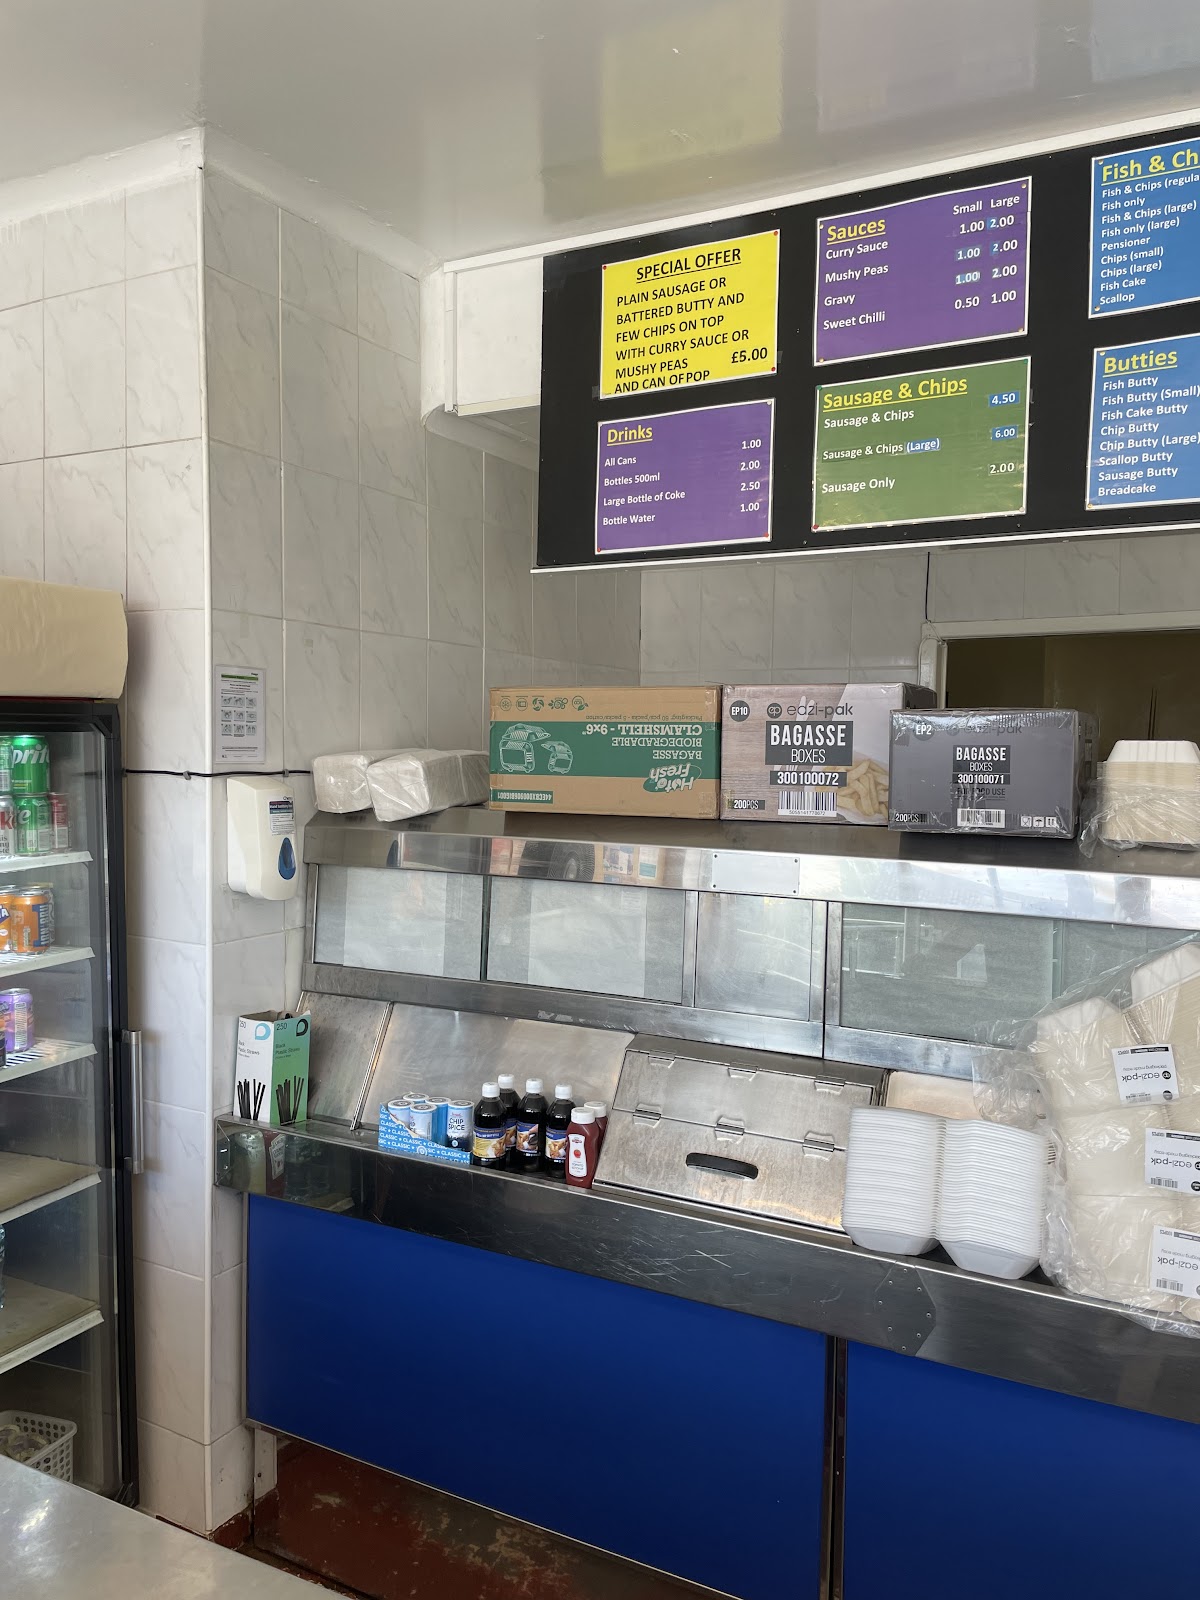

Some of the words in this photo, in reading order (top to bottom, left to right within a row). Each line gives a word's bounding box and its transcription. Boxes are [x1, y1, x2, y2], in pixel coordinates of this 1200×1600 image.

[1102, 160, 1141, 182] Fish
[1149, 155, 1165, 172] &
[1102, 185, 1121, 198] Fish
[1124, 183, 1132, 193] &
[1135, 180, 1162, 192] Chips
[953, 201, 982, 215] Small
[990, 195, 1020, 210] Large
[1102, 198, 1120, 211] Fish
[1124, 197, 1145, 208] only
[1102, 211, 1120, 224] Fish
[1124, 210, 1132, 220] &
[1135, 207, 1161, 219] Chips
[1164, 200, 1197, 215] (large)
[827, 219, 885, 242] Sauces
[960, 221, 984, 234] 1.00
[989, 215, 1014, 228] 2.00
[1102, 225, 1120, 238] Fish
[1124, 223, 1145, 234] only
[1147, 217, 1180, 232] (large)
[826, 246, 854, 260] Curry
[857, 241, 888, 254] Sauce
[957, 247, 980, 260] 1.00
[992, 240, 1018, 252] 2.00
[1101, 237, 1150, 251] Pensioner
[1101, 252, 1127, 265] Chips
[1130, 246, 1163, 261] (small)
[636, 258, 690, 281] SPECIAL
[696, 248, 741, 268] OFFER
[1101, 266, 1127, 278] Chips
[1130, 260, 1162, 275] (large)
[825, 269, 861, 283] Mushy
[864, 265, 888, 277] Peas
[956, 272, 979, 285] 1.00
[992, 265, 1017, 278] 2.00
[1100, 280, 1119, 291] Fish
[1122, 277, 1146, 288] Cake
[617, 291, 649, 307] PLAIN
[652, 280, 706, 300] SAUSAGE
[709, 277, 726, 289] OR
[1100, 293, 1134, 305] Scallop
[824, 294, 855, 306] Gravy
[955, 297, 980, 310] 0.50
[991, 290, 1016, 304] 1.00
[617, 305, 673, 325] BATTERED
[677, 297, 714, 314] BUTTY
[717, 292, 744, 306] AND
[824, 316, 856, 330] Sweet
[859, 311, 885, 325] Chilli
[617, 329, 640, 342] FEW
[644, 323, 676, 338] CHIPS
[679, 318, 696, 331] ON
[700, 315, 724, 328] TOP
[616, 346, 645, 361] WITH
[649, 340, 686, 356] CURRY
[690, 334, 728, 349] SAUCE
[732, 330, 749, 341] OR
[731, 347, 767, 364] £5.00
[1104, 350, 1177, 373] Butties
[616, 364, 656, 379] MUSHY
[660, 359, 688, 372] PEAS
[614, 380, 639, 394] AND
[642, 376, 666, 390] CAN
[1103, 379, 1124, 391] Fish
[1128, 376, 1158, 388] Butty
[823, 388, 892, 409] Sausage
[898, 383, 912, 398] &
[918, 377, 967, 396] Chips
[992, 393, 1015, 405] 4.50
[1102, 394, 1123, 406] Fish
[1127, 391, 1157, 402] Butty
[1160, 384, 1200, 400] (Small)
[824, 416, 868, 428] Sausage
[872, 413, 881, 423] &
[884, 409, 914, 422] Chips
[1102, 409, 1122, 421] Fish
[1126, 407, 1153, 418] Cake
[1156, 404, 1188, 415] Butty
[607, 425, 652, 443] Drinks
[995, 428, 1015, 439] 6.00
[1101, 425, 1125, 436] Chip
[1129, 422, 1159, 434] Butty
[742, 439, 761, 450] 1.00
[823, 448, 862, 460] Sausage
[865, 445, 873, 455] &
[876, 443, 903, 454] Chips
[906, 438, 940, 453] (Large)
[1100, 440, 1124, 452] Chip
[1128, 436, 1158, 448] Butty
[1161, 432, 1200, 447] (Large)
[605, 457, 615, 467] All
[617, 456, 636, 465] Cans
[740, 460, 760, 471] 2.00
[1099, 454, 1138, 466] Scallop
[1142, 452, 1172, 463] Butty
[990, 463, 1015, 474] 2.00
[1099, 469, 1143, 481] Sausage
[1147, 466, 1178, 478] Butty
[604, 476, 632, 486] Bottles
[635, 473, 660, 483] 500ml
[741, 481, 760, 492] 2.50
[822, 480, 866, 493] Sausage
[869, 478, 895, 489] Only
[1098, 482, 1156, 496] Breadcake
[603, 496, 625, 508] Large
[627, 493, 652, 504] Bottle
[654, 492, 663, 501] of
[665, 490, 685, 500] Coke
[740, 502, 759, 513] 1.00
[603, 515, 627, 526] Bottle
[629, 513, 655, 523] Water
[731, 707, 747, 716] EP10
[787, 703, 853, 718] eazi-pak
[618, 724, 702, 735] CLAMSHELL
[770, 725, 846, 746] BAGASSE
[916, 725, 931, 735] EP2
[612, 737, 702, 746] BIODEGRADABLE
[653, 750, 702, 759] BAGASSE
[791, 749, 825, 763] BOXES
[956, 748, 1006, 760] BAGASSE
[650, 763, 690, 779] Fresh
[970, 763, 992, 771] BOXES
[777, 772, 839, 786] 300100072
[958, 774, 1004, 784] 300100071
[734, 800, 758, 810] 200PCS
[895, 813, 918, 822] 200PCS
[1122, 1073, 1160, 1082] eazi-pak
[381, 1120, 397, 1128] CLASSIC
[1150, 1157, 1192, 1168] eazi-pak
[1157, 1257, 1198, 1271] eazi-pak
